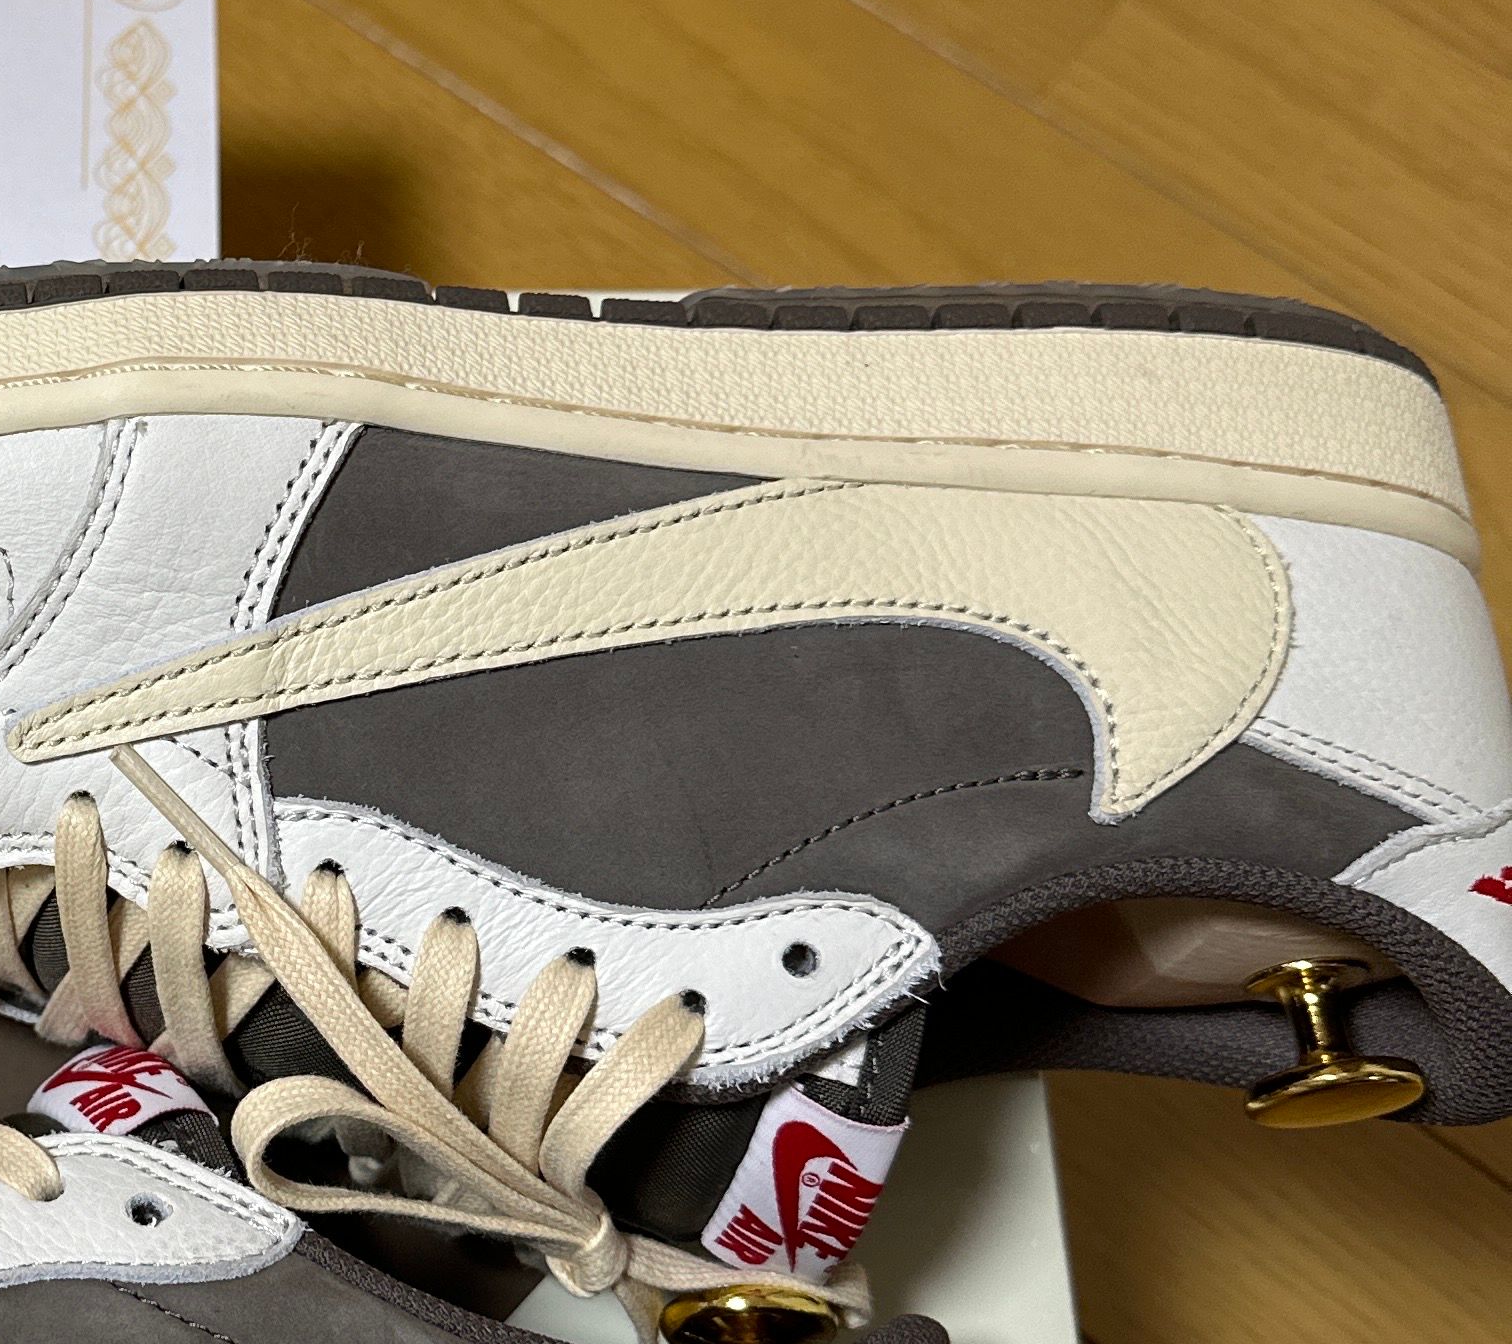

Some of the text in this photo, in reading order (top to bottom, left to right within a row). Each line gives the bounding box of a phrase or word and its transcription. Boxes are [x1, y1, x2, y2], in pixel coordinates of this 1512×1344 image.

[69, 1083, 142, 1133] AIR
[714, 1203, 785, 1265] AIR
[797, 1160, 884, 1261] NIKE
